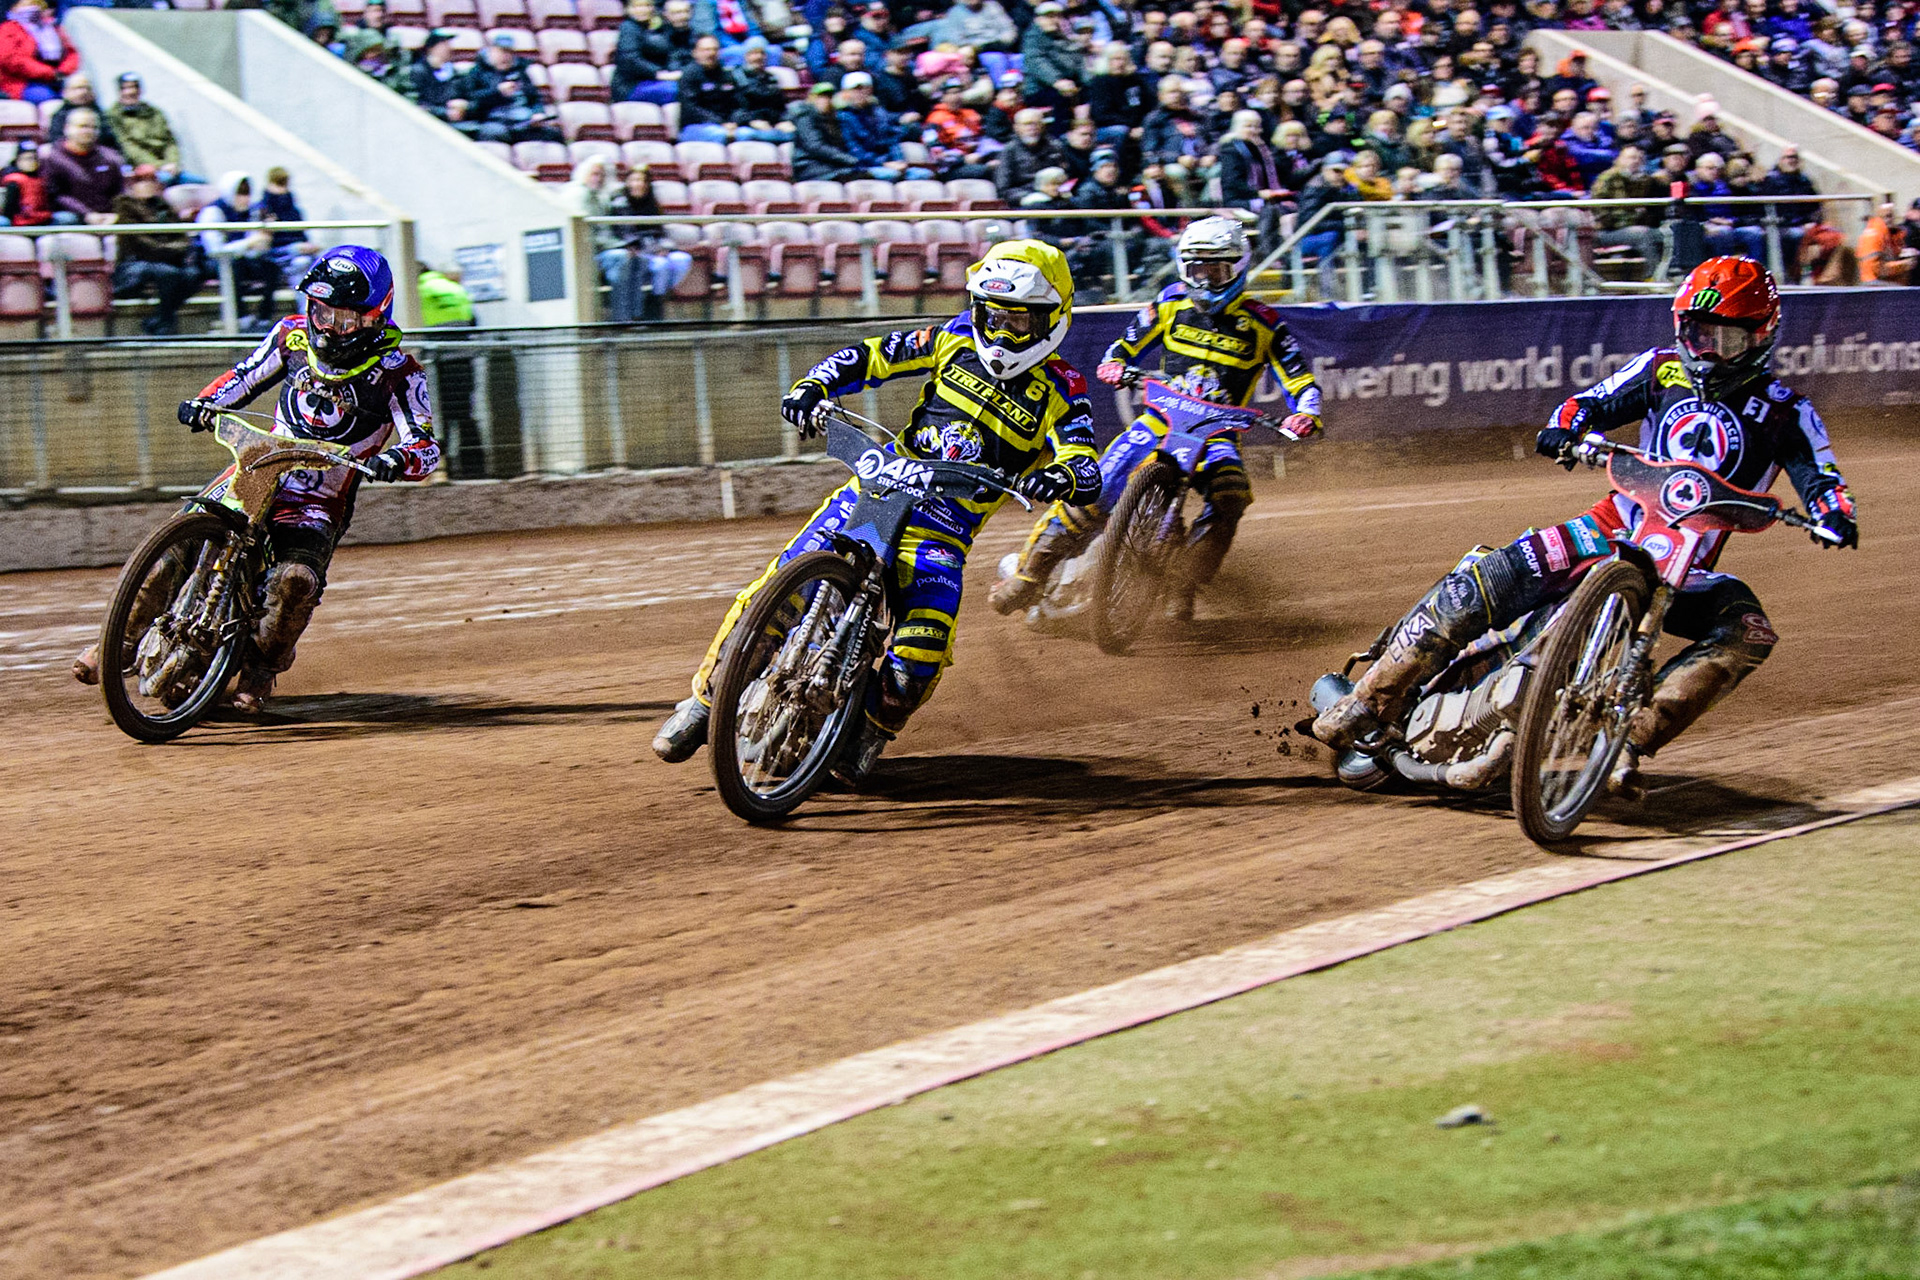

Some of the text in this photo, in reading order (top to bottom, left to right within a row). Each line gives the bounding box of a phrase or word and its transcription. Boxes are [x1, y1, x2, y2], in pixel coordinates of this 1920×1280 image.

[1458, 345, 1563, 391] world
[1025, 380, 1046, 401] 6
[1666, 403, 1698, 425] BELLE
[1724, 421, 1739, 450] ACES
[1520, 540, 1542, 578] DOCUFY
[916, 575, 960, 592] poultec
